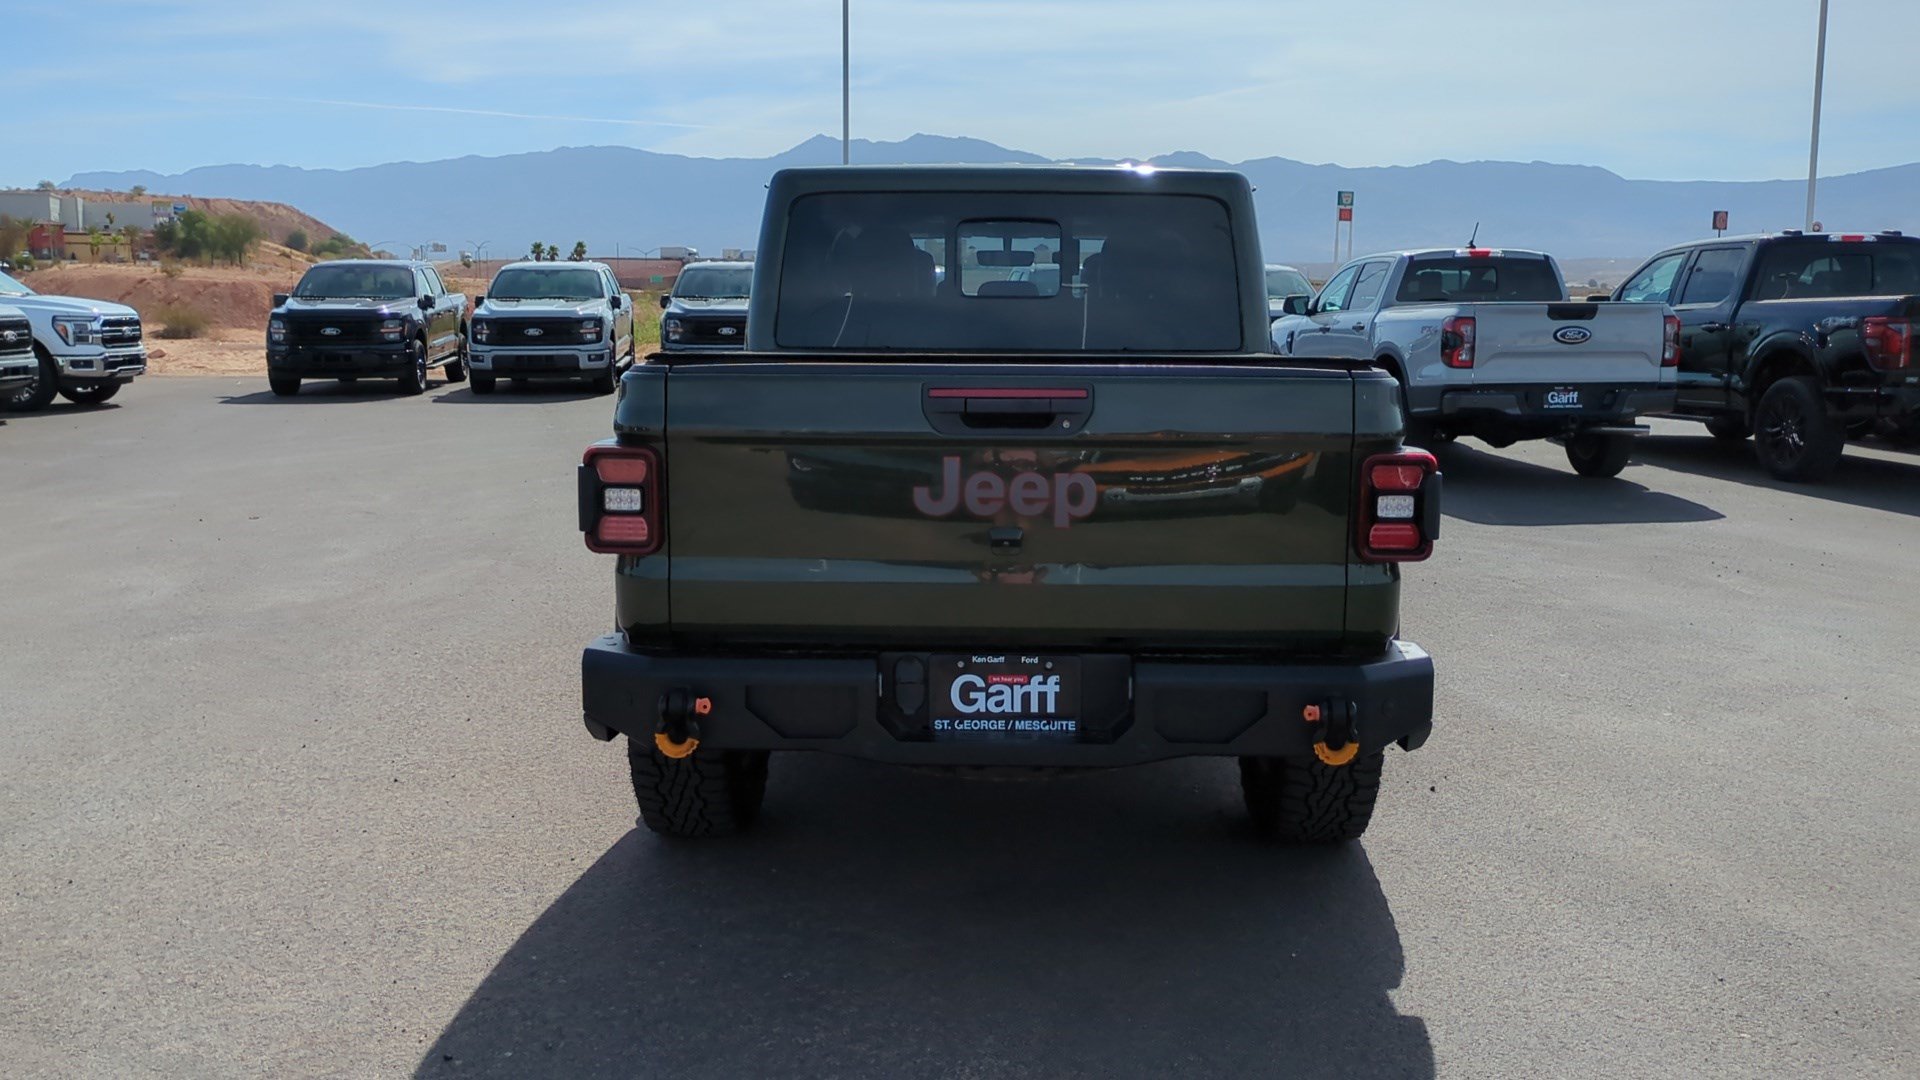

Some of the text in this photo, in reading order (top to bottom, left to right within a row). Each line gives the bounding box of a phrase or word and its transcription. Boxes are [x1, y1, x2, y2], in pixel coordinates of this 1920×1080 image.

[1548, 391, 1578, 404] Garff
[913, 456, 1097, 528] Jeep
[1021, 656, 1039, 664] Ford
[950, 674, 1060, 714] Garff
[934, 720, 951, 730] ST.
[954, 720, 1006, 730] GEORGE
[1015, 720, 1076, 731] MESQUITE
